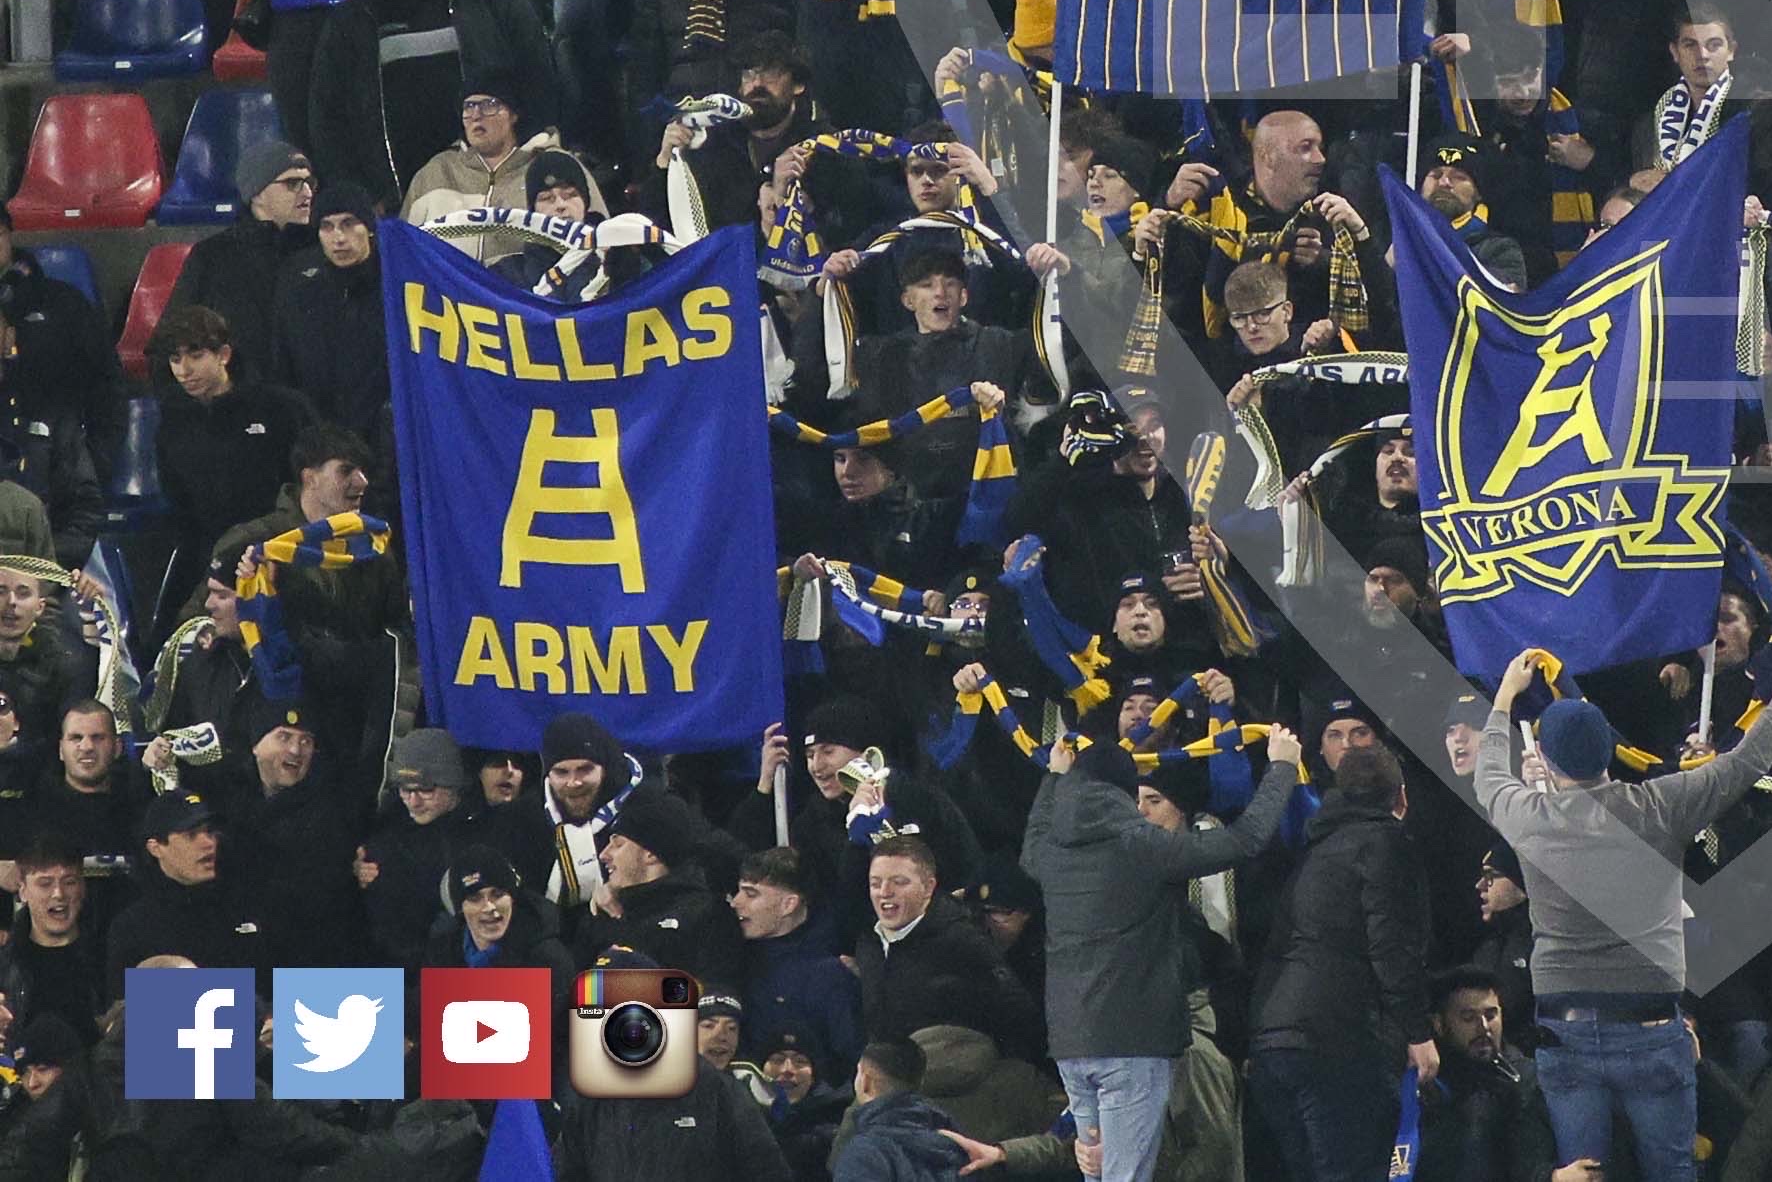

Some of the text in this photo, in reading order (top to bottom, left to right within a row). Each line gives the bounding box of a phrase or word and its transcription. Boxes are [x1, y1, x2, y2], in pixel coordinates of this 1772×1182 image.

[404, 282, 733, 381] HELLAS
[1462, 485, 1636, 548] VERONA
[454, 615, 709, 696] ARMY
